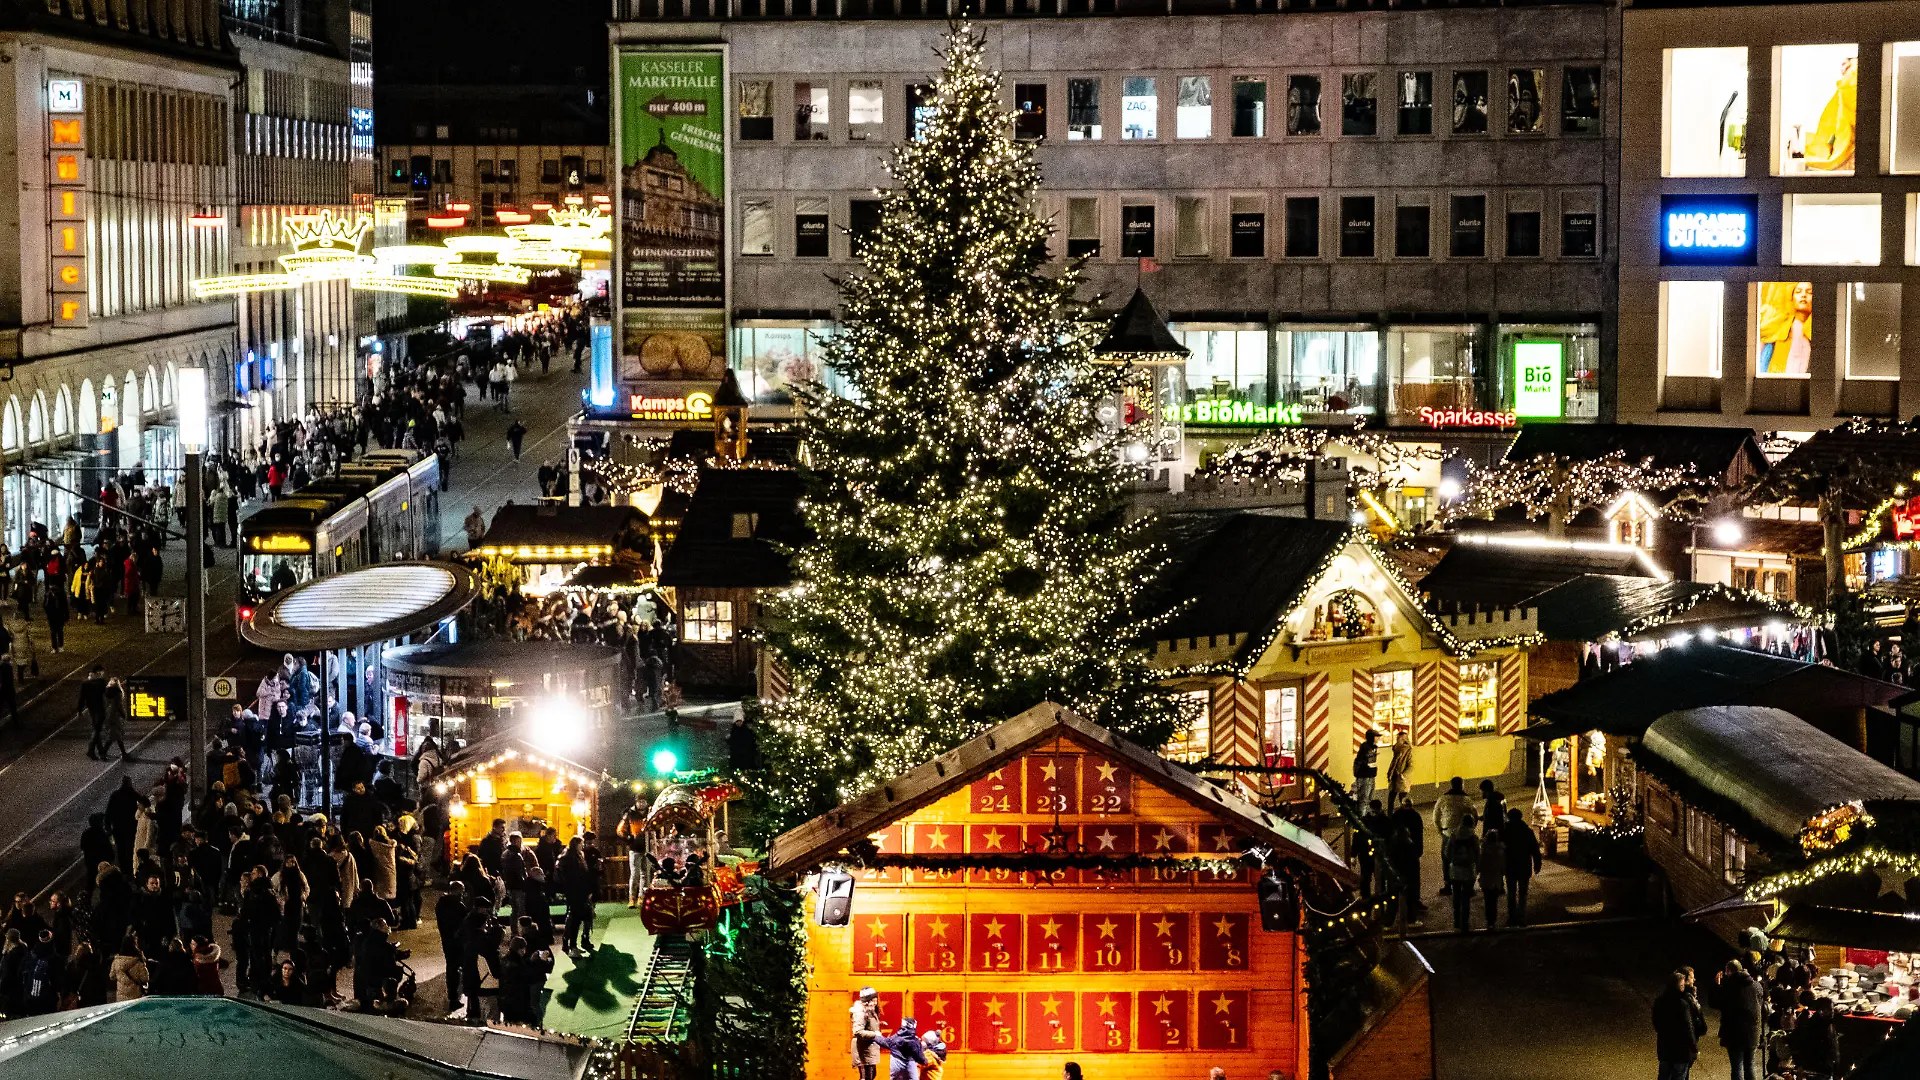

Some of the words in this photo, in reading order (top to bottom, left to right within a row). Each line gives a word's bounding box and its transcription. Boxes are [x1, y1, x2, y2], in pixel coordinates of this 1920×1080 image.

[641, 61, 703, 73] KASSELER
[629, 76, 717, 88] MARKTHALLE
[59, 91, 71, 102] M
[649, 103, 669, 111] nur
[672, 102, 693, 111] 400
[1127, 101, 1147, 111] ZAG
[52, 119, 80, 320] Müller
[1348, 219, 1371, 227] olunta
[630, 395, 685, 412] Kamps
[1420, 407, 1517, 429] Sparkasse
[981, 795, 1011, 812] 24
[1037, 794, 1067, 812] 23
[1091, 795, 1121, 812] 22
[865, 951, 894, 968] 14
[927, 951, 956, 968] 13
[982, 951, 1010, 968] 12
[1039, 952, 1065, 969] 11
[1095, 950, 1121, 966] 10
[1169, 949, 1182, 965] 9
[1227, 950, 1241, 966] 8
[941, 1026, 955, 1043] 6
[998, 1028, 1012, 1044] 5
[1052, 1027, 1066, 1044] 4
[1108, 1029, 1122, 1047] 3
[1167, 1028, 1180, 1045] 2
[1228, 1028, 1239, 1044] 1
